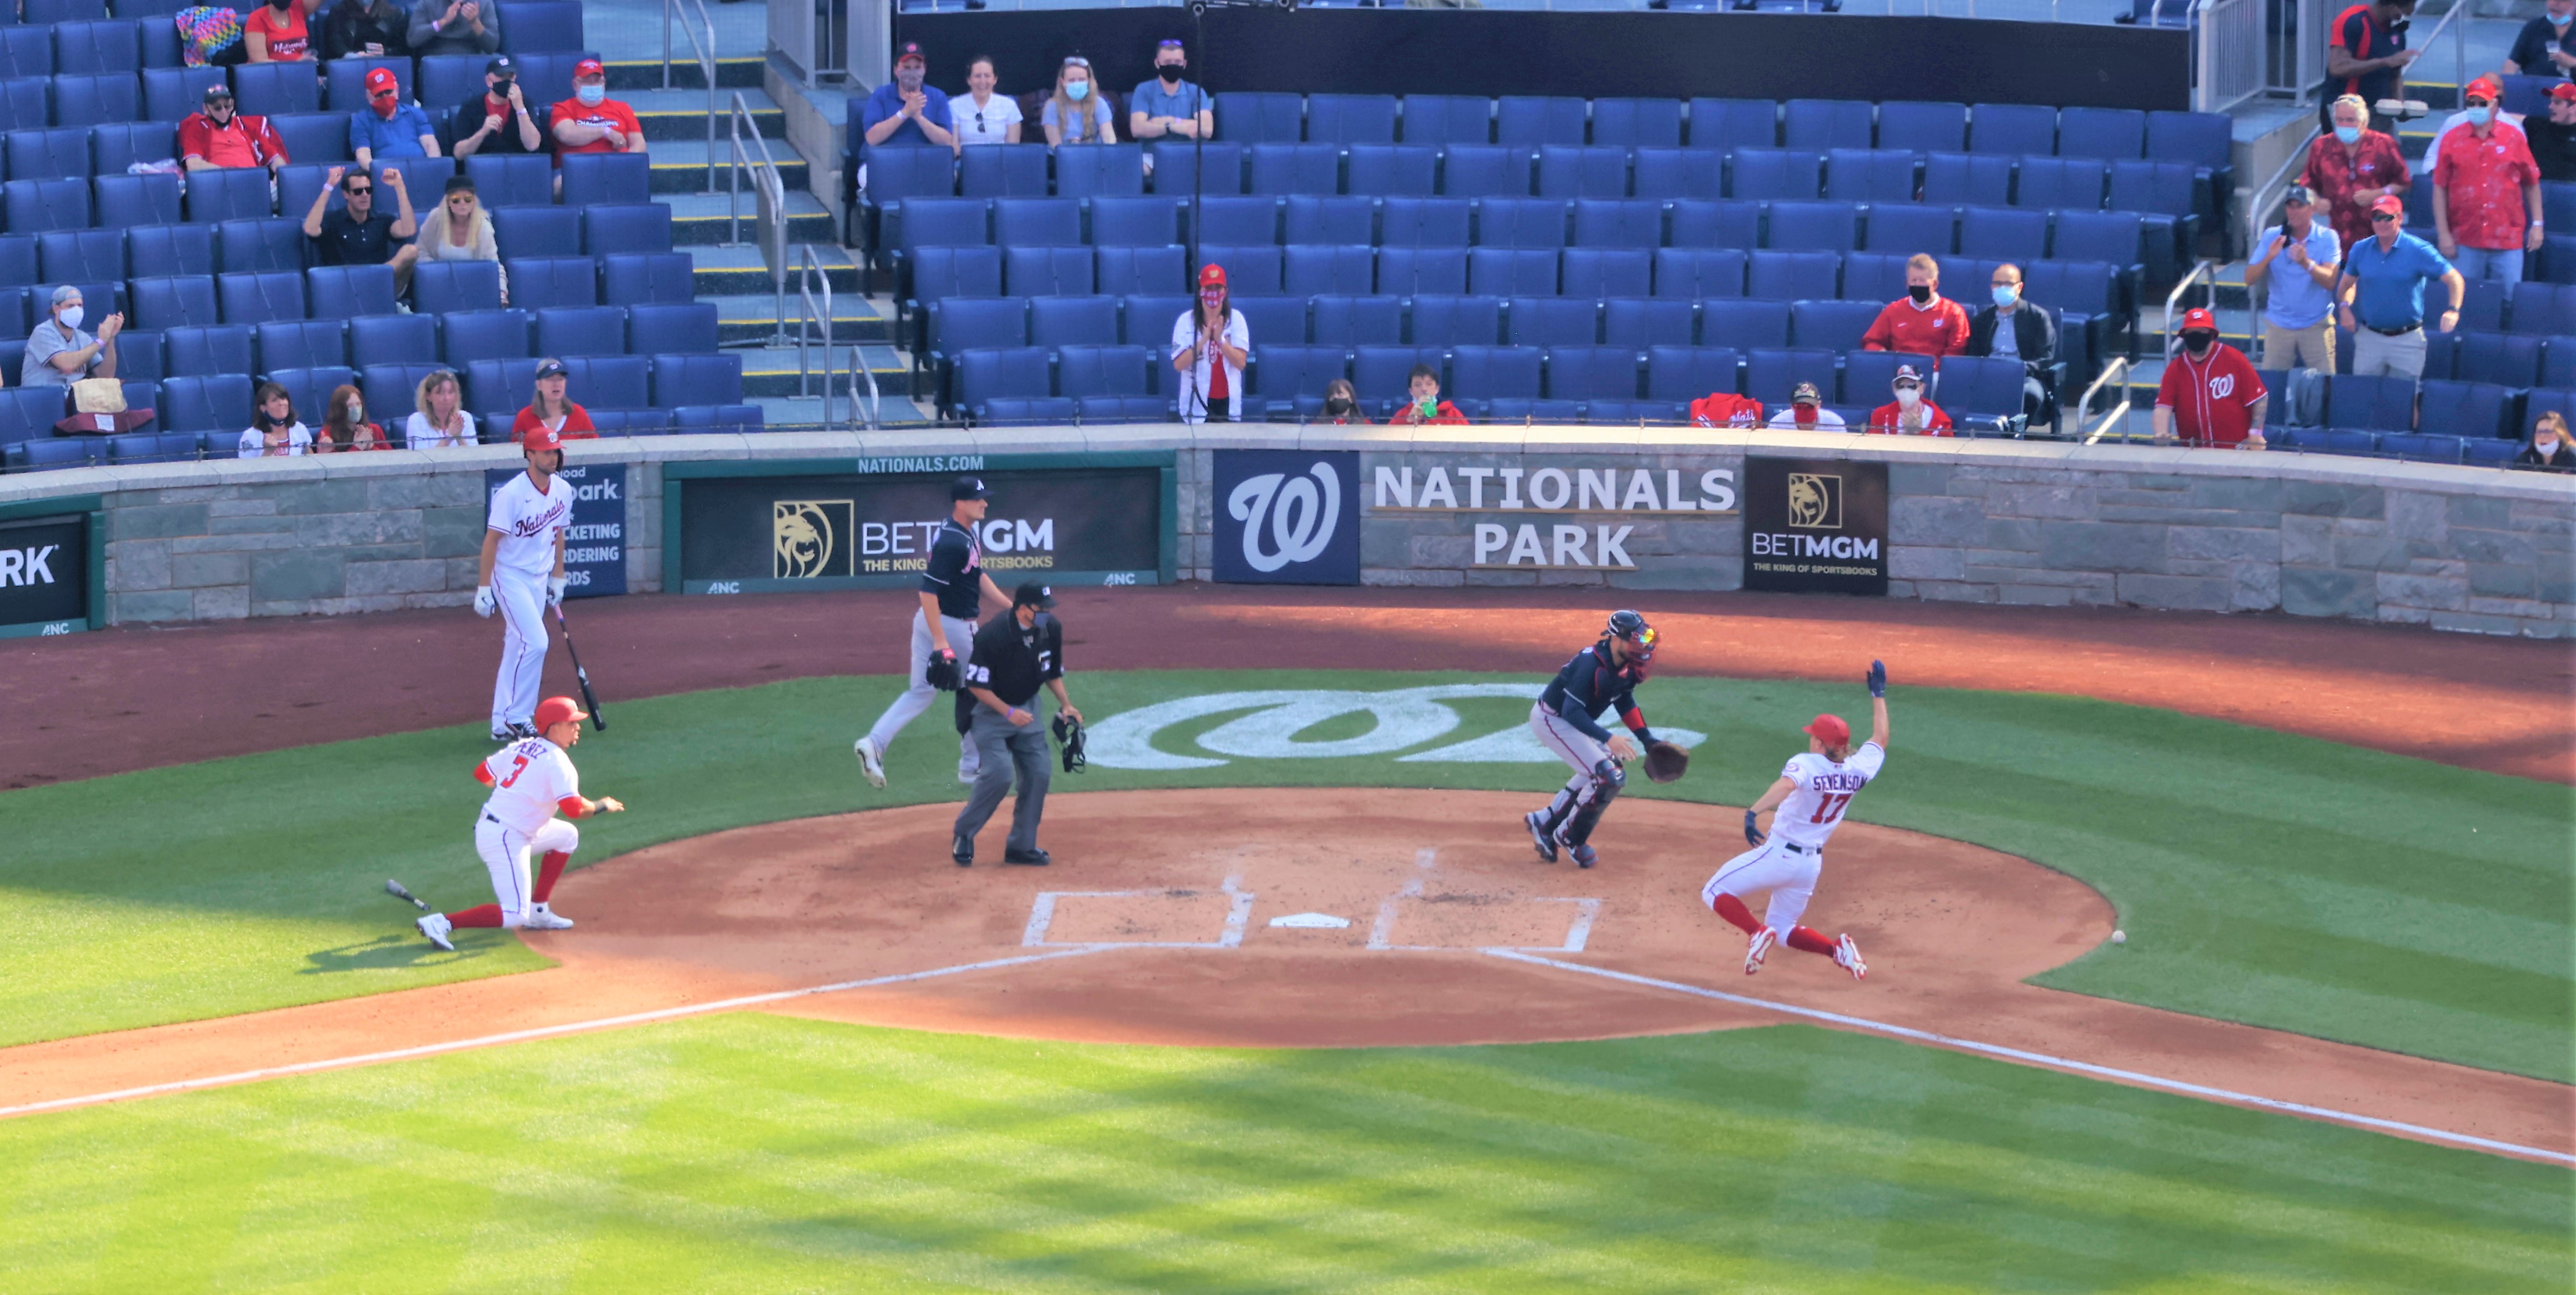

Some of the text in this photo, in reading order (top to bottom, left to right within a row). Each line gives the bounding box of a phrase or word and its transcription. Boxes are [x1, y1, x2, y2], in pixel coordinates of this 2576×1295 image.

[2209, 374, 2234, 399] W
[858, 456, 984, 474] NATIONALS.COM
[1375, 466, 1735, 511] NATIONALS
[515, 497, 565, 538] Nationals
[1228, 462, 1341, 572] W
[1474, 523, 1635, 567] PARK
[1752, 532, 1878, 560] BETMGM
[863, 560, 889, 572] THE
[893, 559, 927, 571] KING
[1753, 563, 1878, 576] THE KING OF SPORTSBOOKS
[707, 582, 740, 595] ANC
[1104, 573, 1135, 586] ANC
[41, 622, 70, 637] ANC
[500, 754, 529, 789] 3
[1810, 793, 1853, 824] 17
